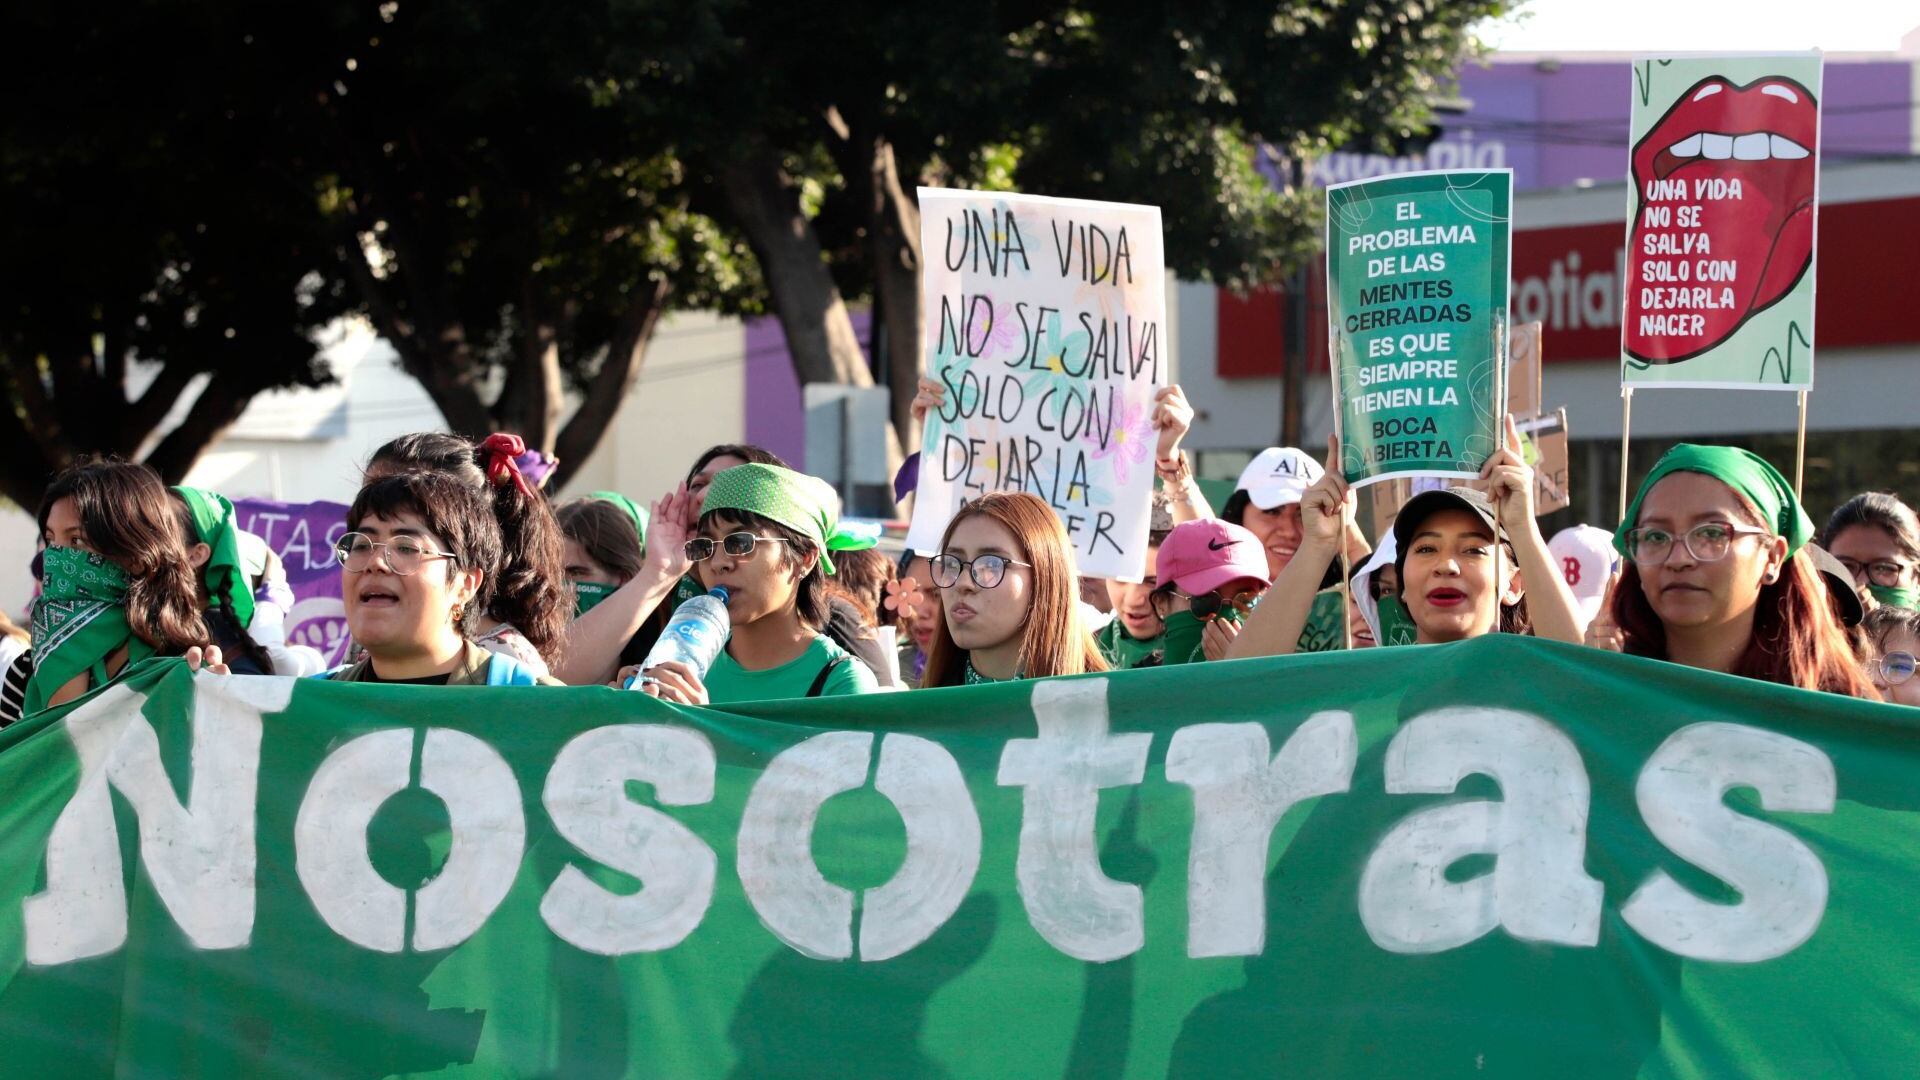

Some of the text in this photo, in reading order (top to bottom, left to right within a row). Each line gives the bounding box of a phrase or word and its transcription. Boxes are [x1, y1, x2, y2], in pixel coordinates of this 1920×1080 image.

[1646, 178, 1742, 201] UNA VIDA
[1396, 202, 1421, 221] EL
[1644, 206, 1702, 228] NO SE
[945, 208, 1133, 286] UNA VIDA
[1348, 225, 1477, 256] PROBLEMA
[1643, 233, 1710, 255] SALVA
[1367, 252, 1446, 279] DE LAS
[1642, 259, 1737, 282] SOLO CON
[1359, 279, 1453, 307] MENTES
[1641, 287, 1735, 310] DEJARLA
[1345, 303, 1472, 334] CERRADAS
[1640, 314, 1705, 337] NACER
[938, 294, 1157, 384] NO SE SALVA
[1369, 332, 1450, 358] ES QUE
[1359, 359, 1458, 387] SIEMPRE
[938, 364, 1115, 451] SOLO CON
[1352, 386, 1459, 416] TIENEN LA
[1372, 416, 1438, 440] BOCA
[1363, 440, 1453, 465] ABIERTA
[1563, 557, 1581, 586] B
[24, 667, 1836, 965] Nosotras
